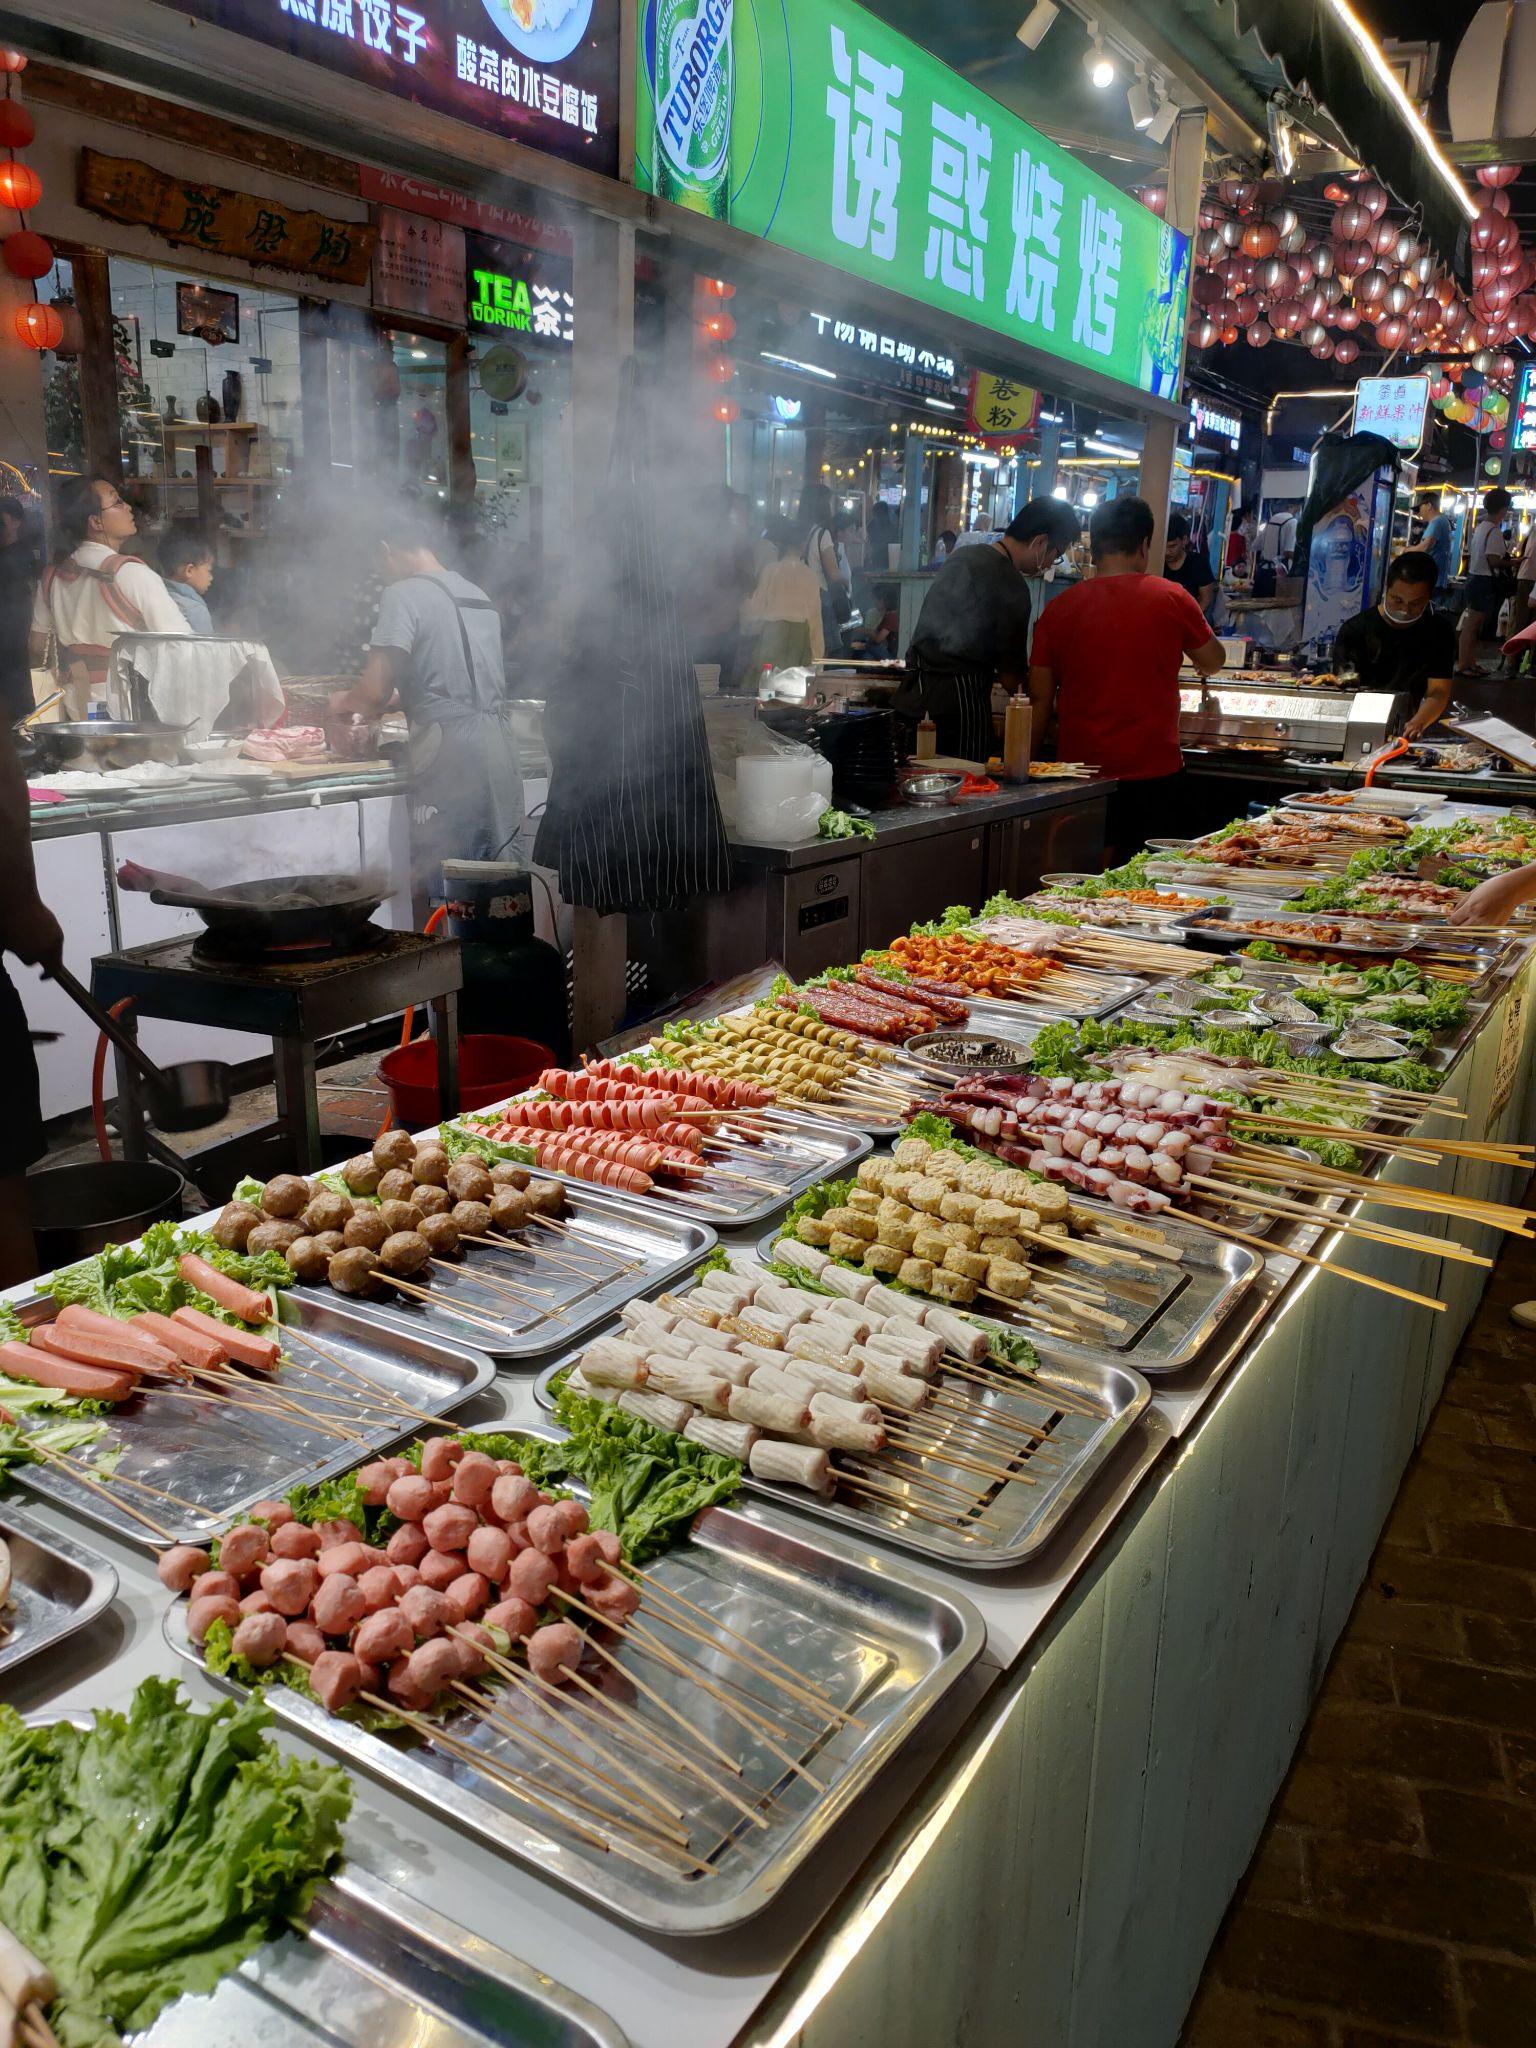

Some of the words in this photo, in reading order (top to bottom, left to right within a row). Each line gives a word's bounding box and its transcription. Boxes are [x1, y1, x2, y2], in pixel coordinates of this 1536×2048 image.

[456, 34, 598, 134] 酸菜肉水豆腐饭
[663, 0, 725, 150] TUBORG
[711, 95, 727, 148] GREEN
[826, 24, 1123, 357] 诱惑烧烤
[473, 268, 532, 315] TEA
[484, 303, 532, 332] DRINK
[986, 378, 1020, 428] 卷粉
[1358, 403, 1424, 421] 新鲜果汁
